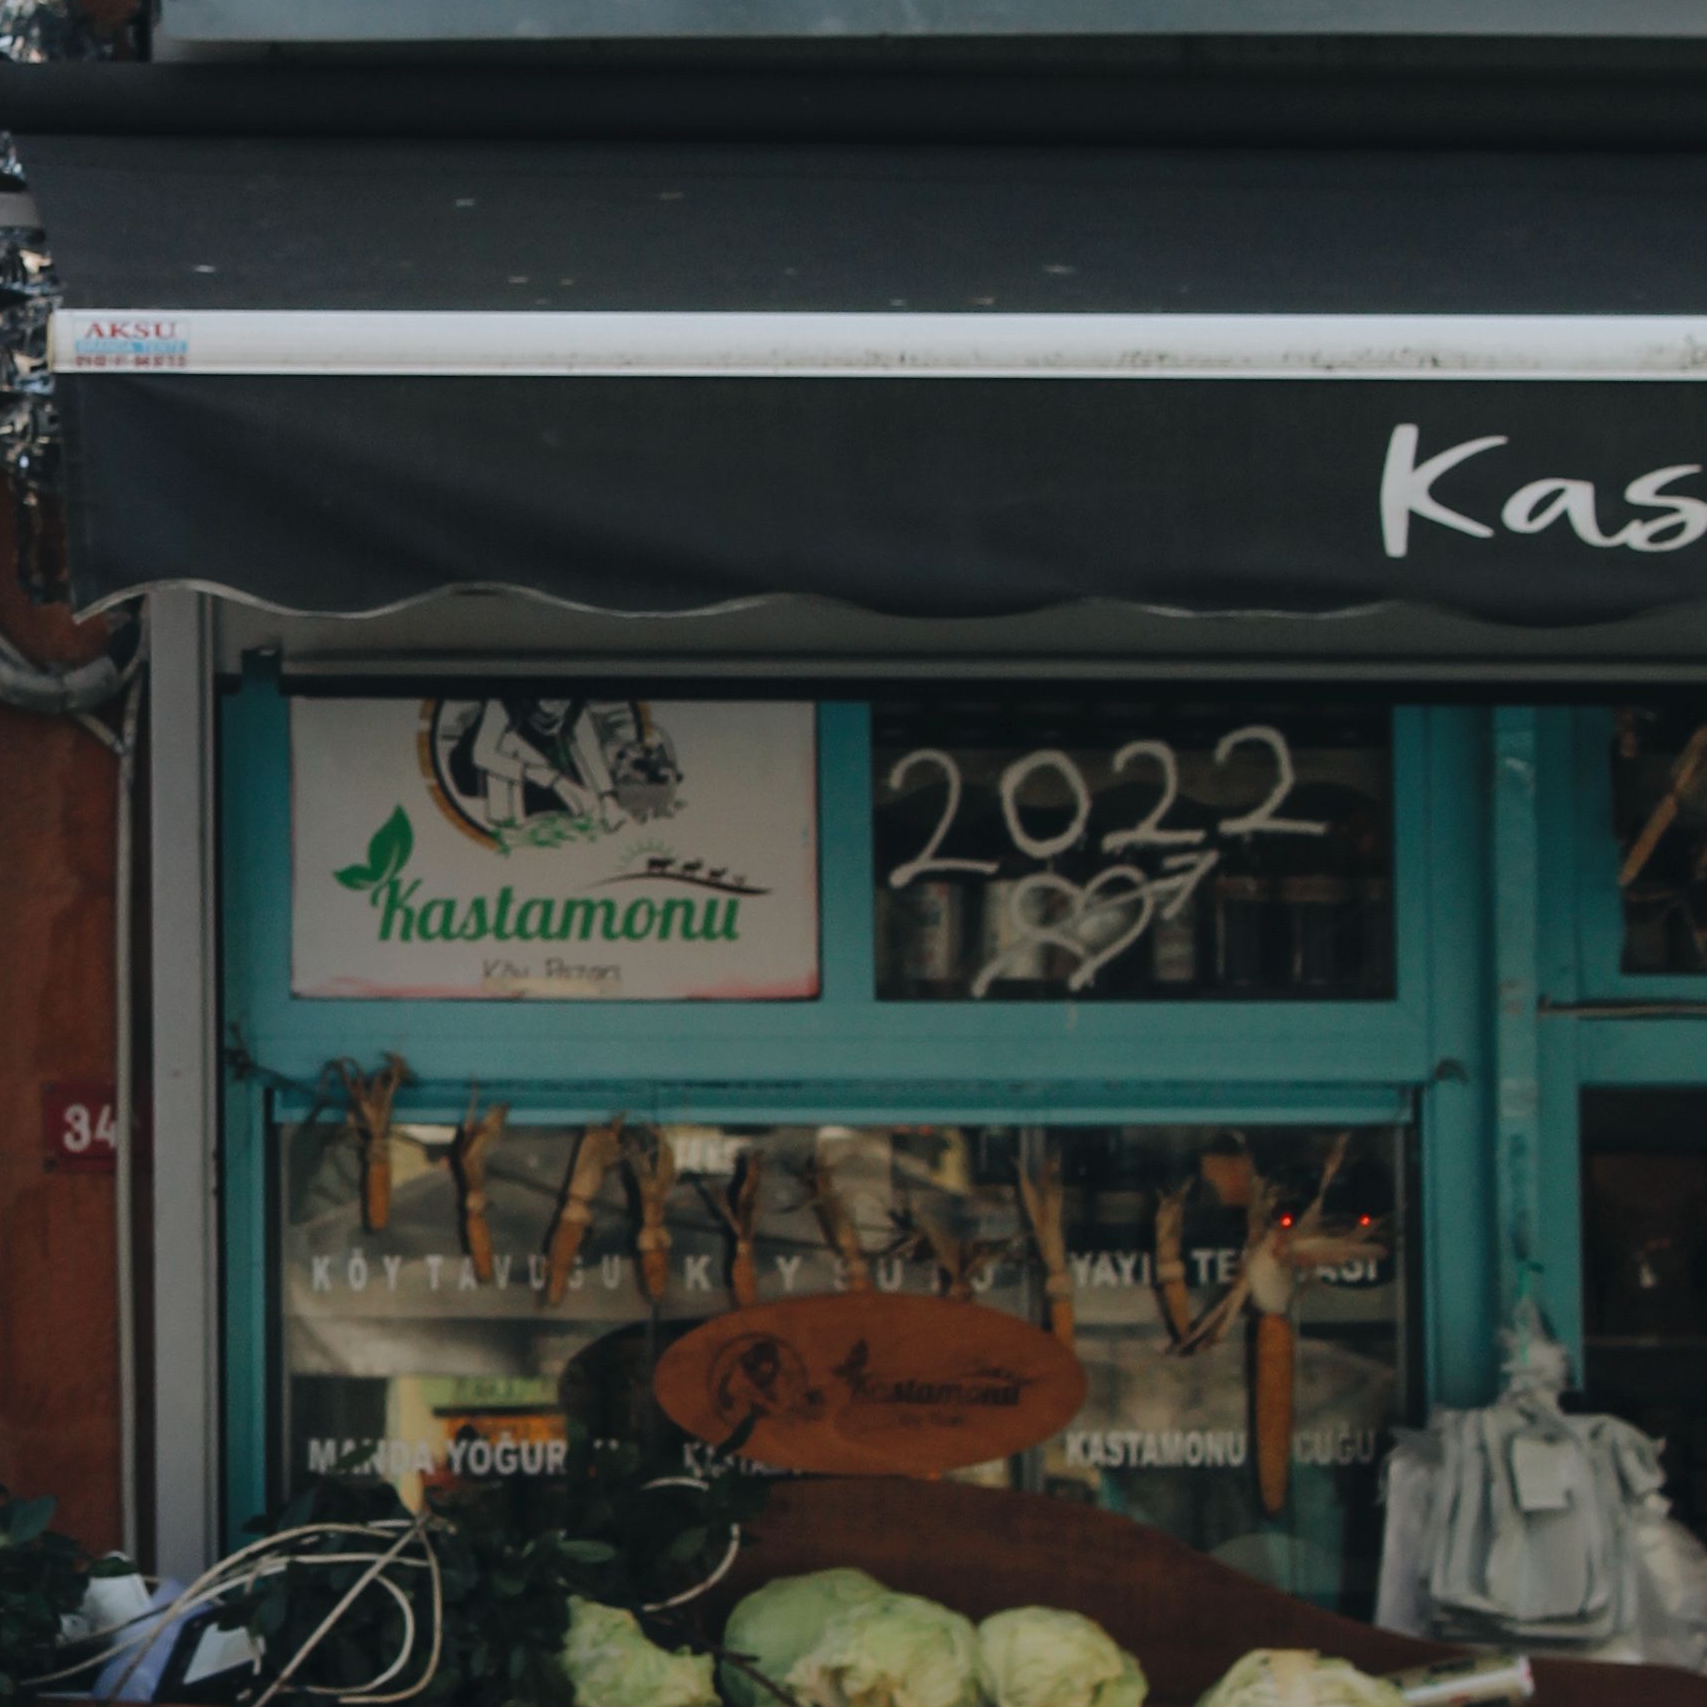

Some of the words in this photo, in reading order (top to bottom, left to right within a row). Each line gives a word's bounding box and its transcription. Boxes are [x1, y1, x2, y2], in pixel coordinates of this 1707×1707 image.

[84, 321, 178, 339] AKSU
[887, 724, 1328, 889] 2022
[369, 877, 741, 943] Kastamonu
[1063, 1430, 1248, 1470] KASTAMONU
